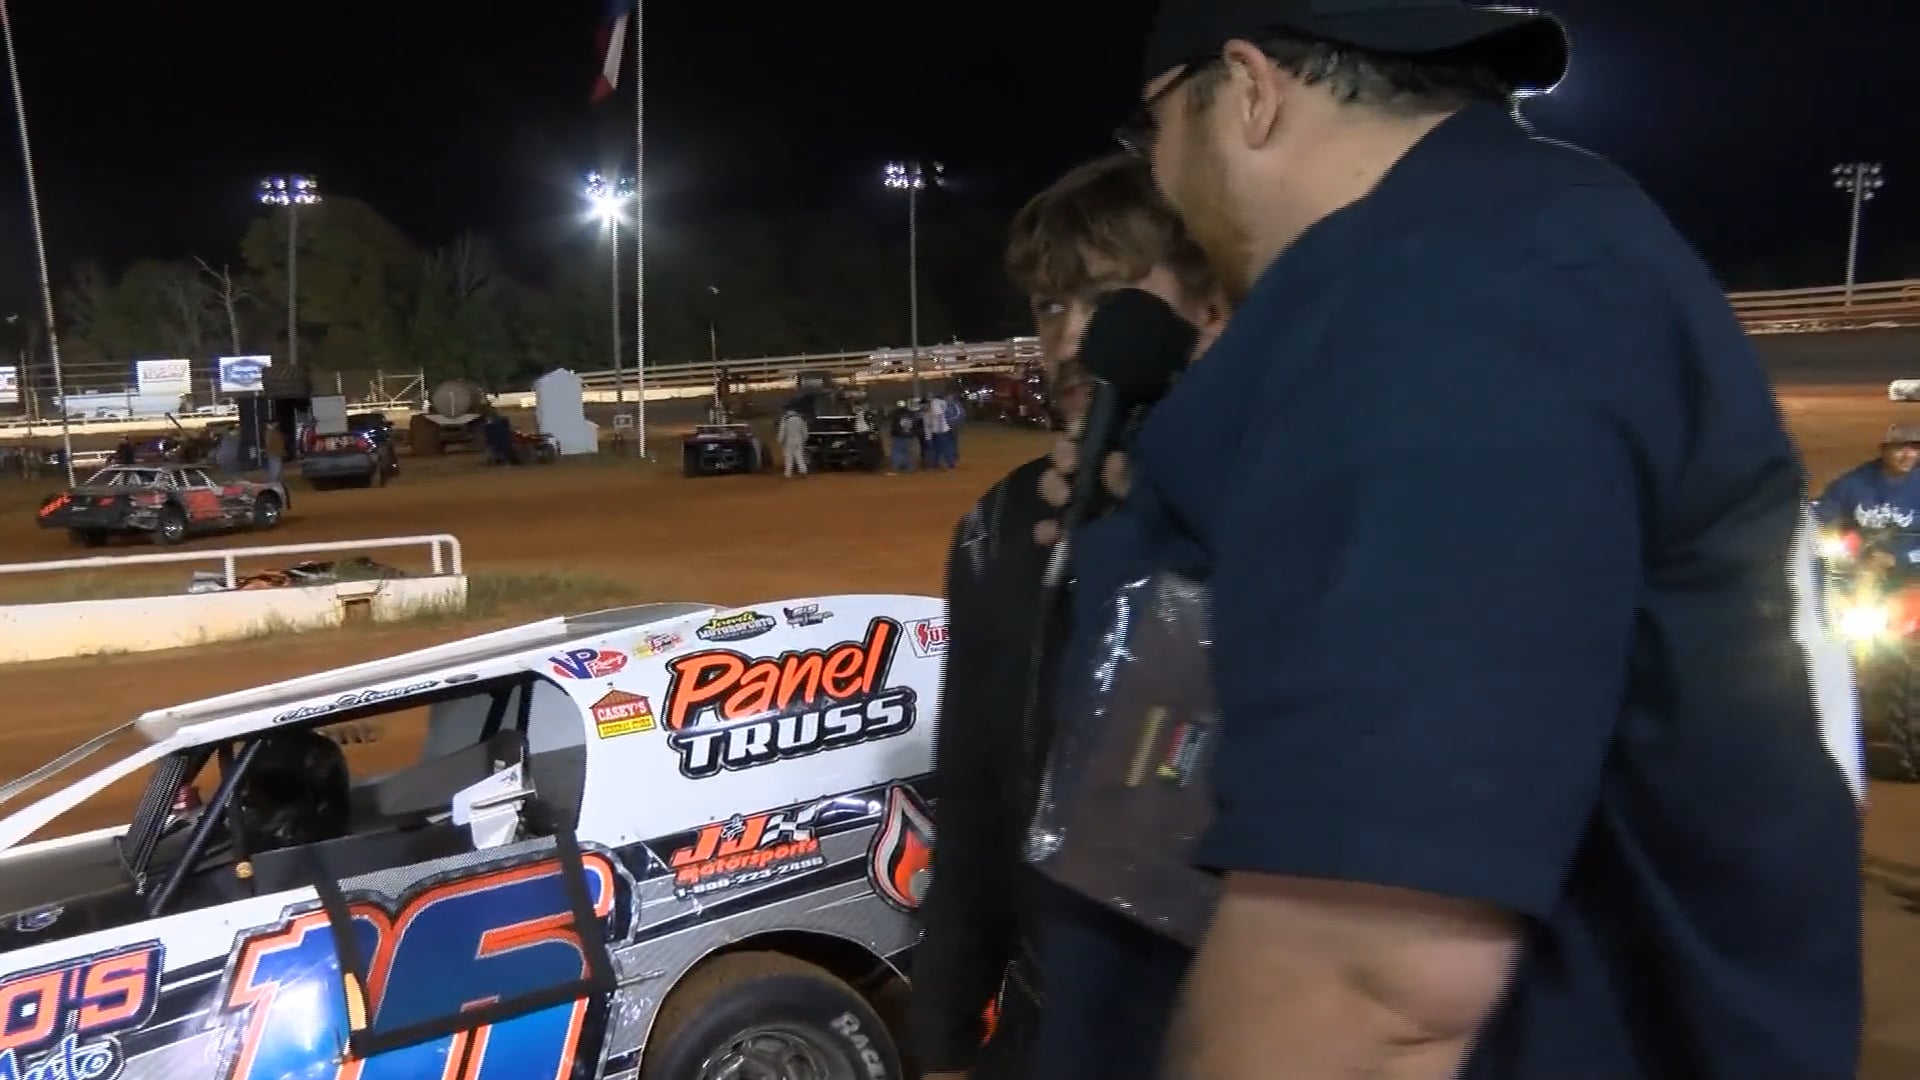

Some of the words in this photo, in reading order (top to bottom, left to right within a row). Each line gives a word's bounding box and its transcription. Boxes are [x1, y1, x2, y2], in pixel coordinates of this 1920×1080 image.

[549, 648, 599, 680] VP
[667, 619, 894, 732] Panel
[597, 701, 648, 722] CASEY'S
[674, 690, 909, 773] TRUSS
